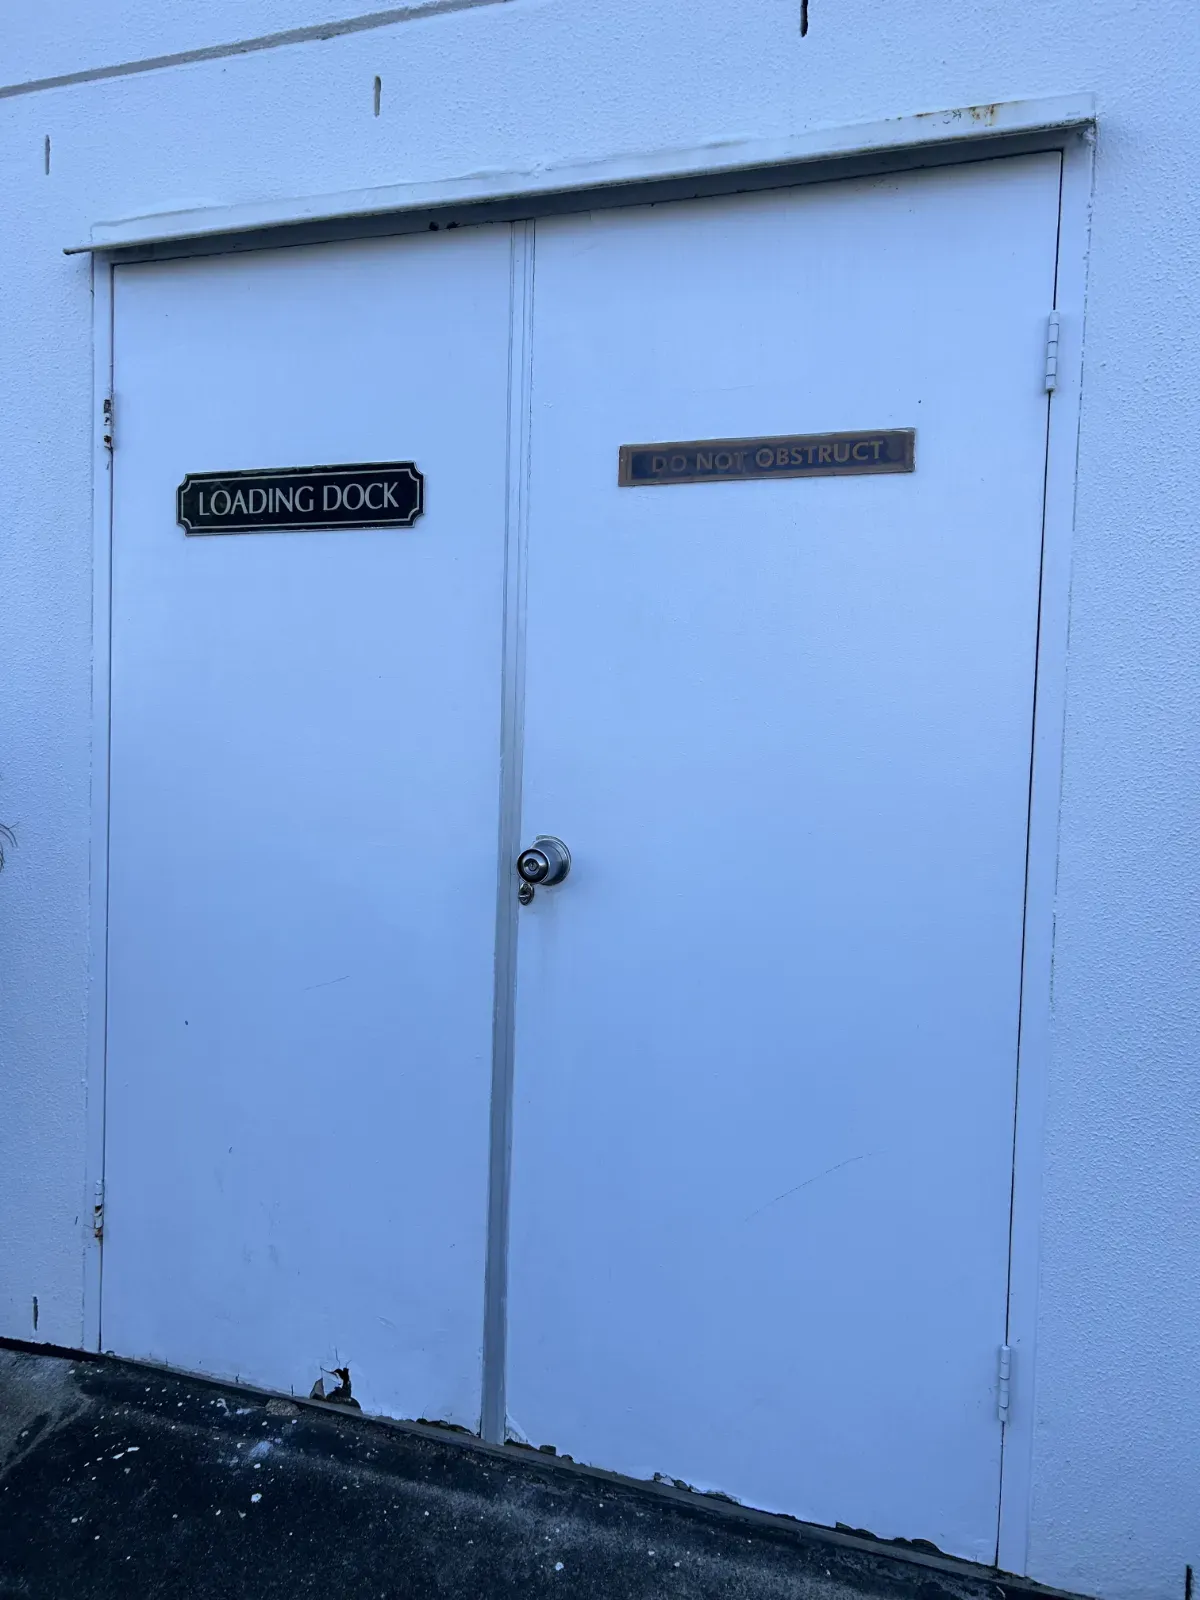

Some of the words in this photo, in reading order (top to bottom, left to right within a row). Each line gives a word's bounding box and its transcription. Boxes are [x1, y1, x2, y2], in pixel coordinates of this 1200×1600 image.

[652, 454, 687, 473] DO
[696, 451, 746, 471] NOT
[755, 440, 884, 468] OBSTRUCT
[199, 486, 315, 516] LOADING
[323, 482, 399, 511] DOCK
